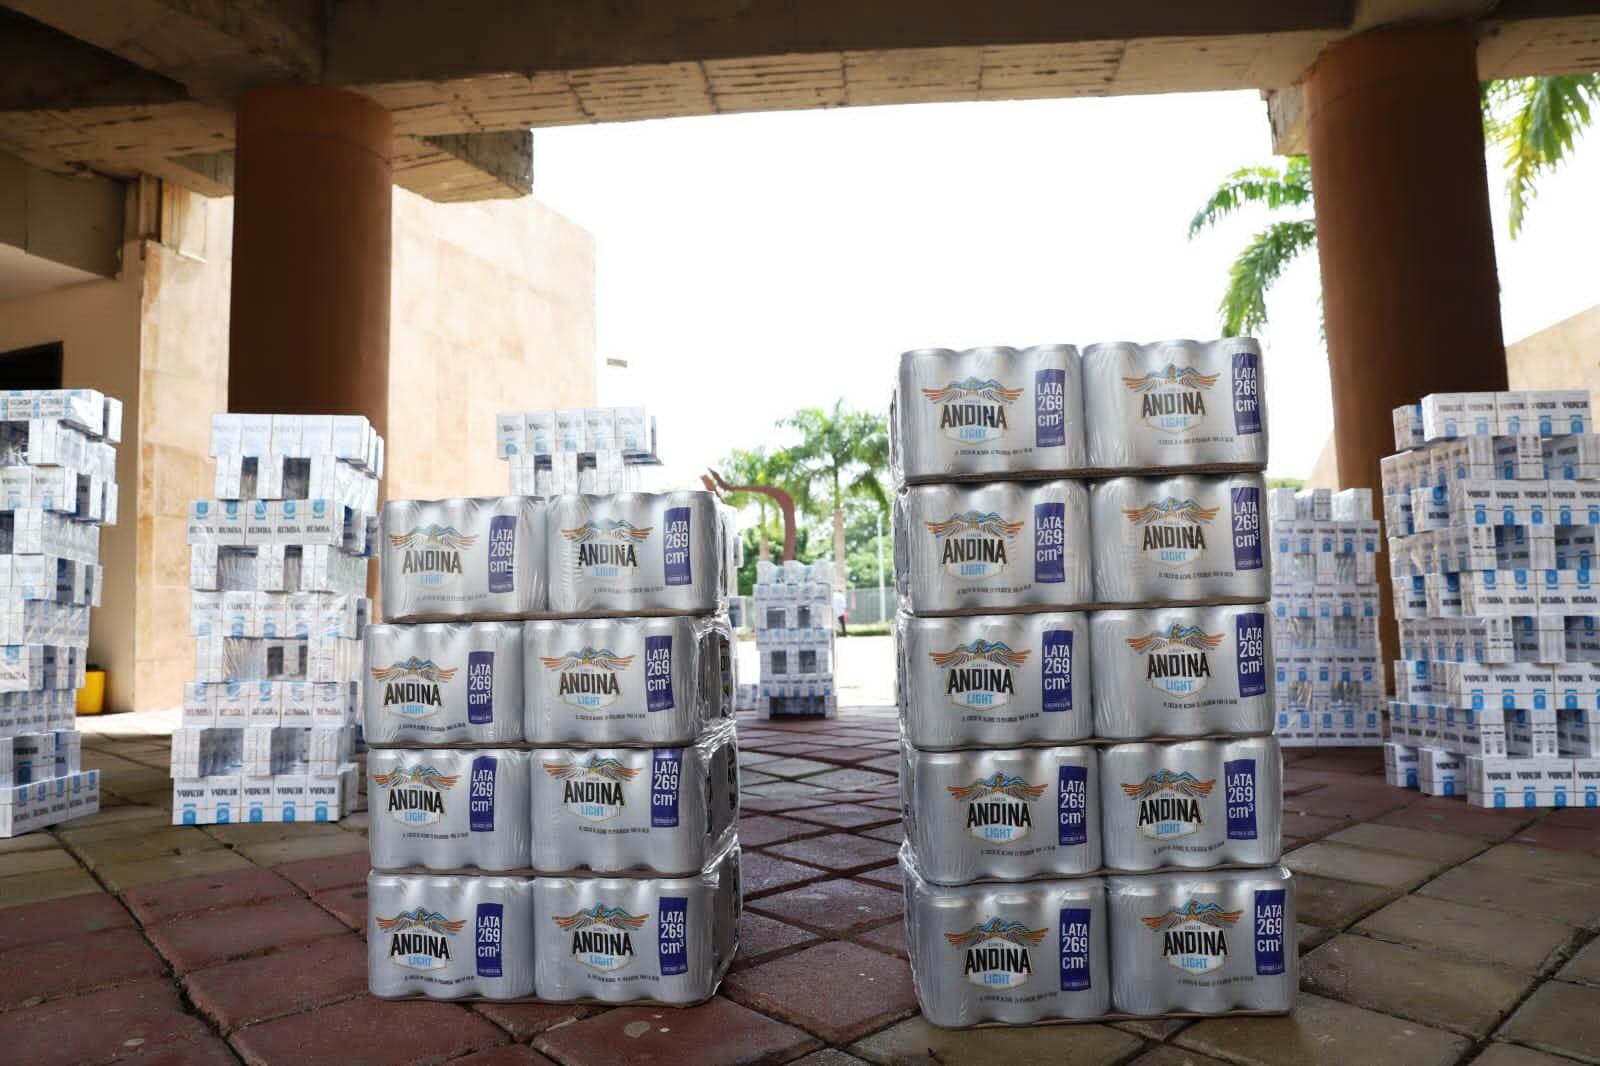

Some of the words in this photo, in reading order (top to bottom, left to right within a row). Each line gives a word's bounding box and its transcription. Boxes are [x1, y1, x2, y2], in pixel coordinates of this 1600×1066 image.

[1235, 367, 1256, 381] LATA
[1038, 382, 1062, 396] LATA
[1235, 381, 1256, 396] 269
[1038, 396, 1063, 411] 269
[1141, 392, 1206, 417] ANDINA
[940, 404, 1007, 429] ANDINA
[959, 428, 986, 440] LIGHT
[1234, 501, 1257, 515] LATA
[665, 522, 688, 534] LATA
[1037, 516, 1062, 529] LATA
[1235, 515, 1259, 530] 269
[491, 529, 513, 541] LATA
[665, 534, 689, 548] 269
[1037, 529, 1062, 545] 269
[1142, 526, 1207, 551] ANDINA
[491, 541, 513, 555] 269
[579, 543, 637, 567] ANDINA
[942, 539, 1007, 564] ANDINA
[402, 551, 462, 574] ANDINA
[1161, 550, 1186, 562] LIGHT
[961, 564, 986, 576] LIGHT
[1239, 627, 1263, 642] LATA
[647, 648, 670, 661] LATA
[1044, 644, 1070, 658] LATA
[1240, 642, 1263, 657] 269
[470, 664, 491, 675] LATA
[647, 661, 670, 675] 269
[1044, 658, 1070, 674] 269
[1148, 652, 1210, 679] ANDINA
[470, 675, 491, 690] 269
[560, 672, 620, 695] ANDINA
[948, 669, 1014, 695] ANDINA
[1166, 679, 1193, 691] LIGHT
[384, 683, 442, 707] ANDINA
[577, 695, 600, 705] LIGHT
[966, 694, 993, 705] LIGHT
[401, 704, 424, 714] LIGHT
[655, 762, 678, 775] LATA
[473, 770, 493, 782] LATA
[655, 775, 678, 790] 269
[1228, 776, 1253, 789] LATA
[472, 782, 493, 796] 269
[563, 780, 624, 805] ANDINA
[1061, 780, 1085, 793] LATA
[388, 790, 444, 813] ANDINA
[1061, 793, 1085, 808] 269
[1228, 789, 1254, 803] 269
[405, 811, 427, 822] LIGHT
[581, 805, 605, 815] LIGHT
[967, 802, 1031, 828] ANDINA
[1138, 799, 1201, 825] ANDINA
[985, 827, 1012, 839] LIGHT
[660, 911, 684, 923] LATA
[1257, 905, 1282, 919] LATA
[478, 917, 500, 928] LATA
[1062, 923, 1088, 936] LATA
[1257, 919, 1282, 936] 269
[479, 928, 500, 942] 269
[660, 923, 684, 938] 269
[391, 934, 449, 959] ANDINA
[572, 931, 633, 956] ANDINA
[1062, 936, 1088, 953] 269
[1163, 930, 1227, 956] ANDINA
[408, 956, 432, 966] LIGHT
[590, 956, 614, 968] LIGHT
[965, 948, 1032, 975] ANDINA
[1181, 956, 1208, 968] LIGHT
